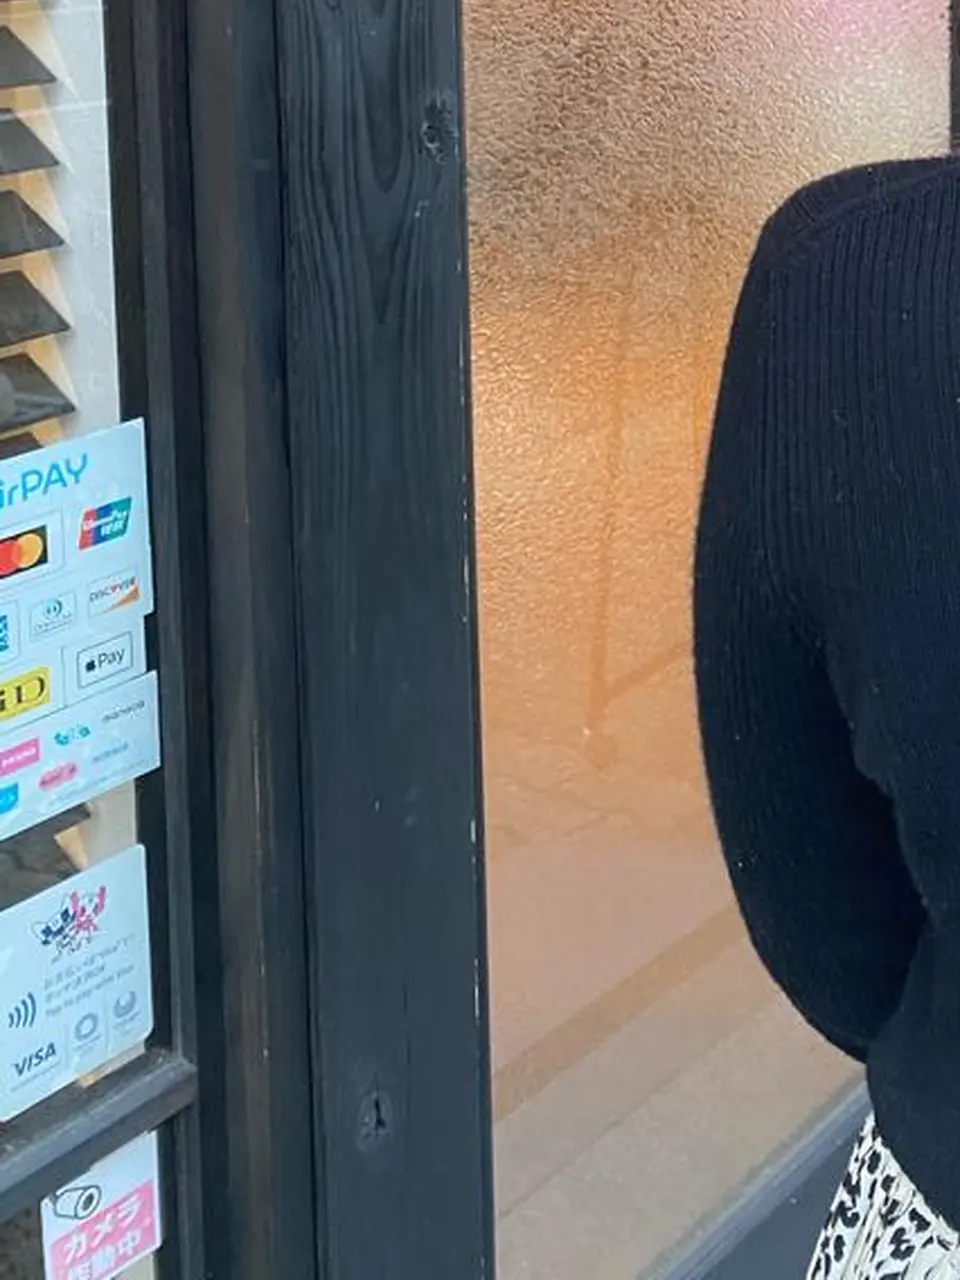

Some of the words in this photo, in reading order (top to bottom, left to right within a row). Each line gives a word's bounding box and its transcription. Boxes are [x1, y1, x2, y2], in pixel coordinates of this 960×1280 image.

[97, 649, 126, 669] Pay
[13, 1041, 57, 1077] VISA
[63, 1193, 143, 1265] カメラ
